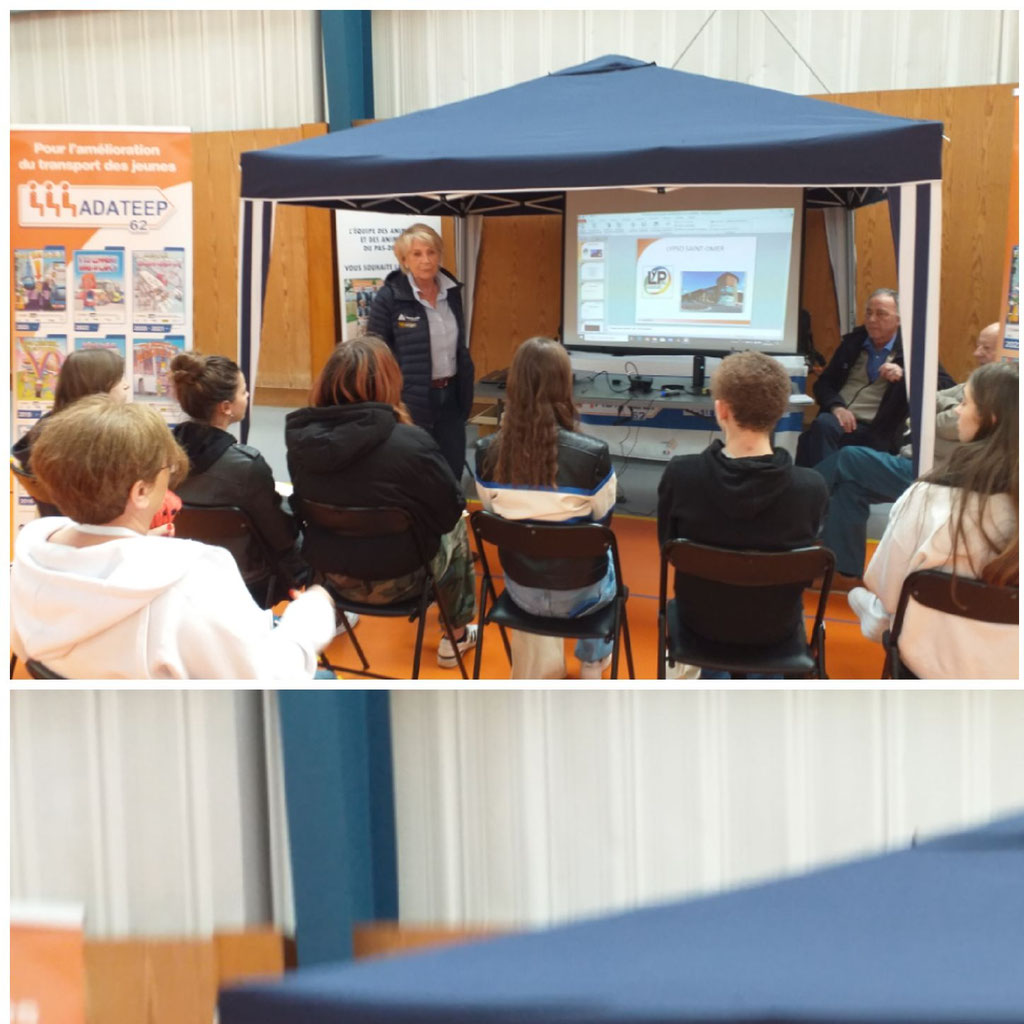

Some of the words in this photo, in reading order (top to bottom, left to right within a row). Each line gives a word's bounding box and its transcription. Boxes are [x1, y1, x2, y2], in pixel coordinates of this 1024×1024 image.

[34, 142, 66, 155] Pour
[69, 142, 161, 156] l'amélioration
[18, 158, 36, 171] du
[38, 158, 101, 174] transport
[104, 159, 129, 172] des
[131, 160, 177, 174] jeunes
[79, 200, 169, 216] ADATEEP
[129, 219, 148, 231] 62
[363, 263, 393, 271] SOUHAITE
